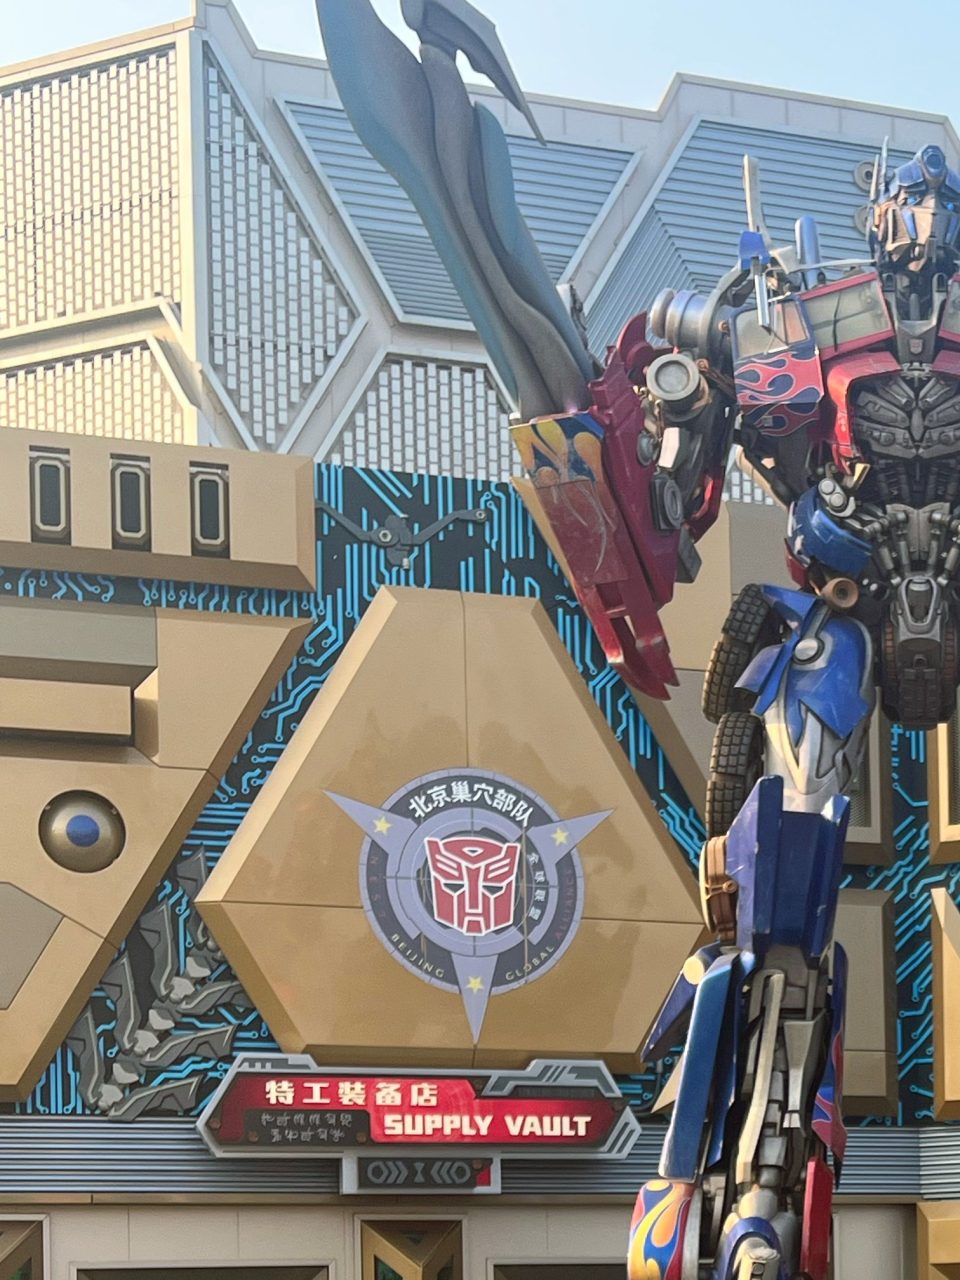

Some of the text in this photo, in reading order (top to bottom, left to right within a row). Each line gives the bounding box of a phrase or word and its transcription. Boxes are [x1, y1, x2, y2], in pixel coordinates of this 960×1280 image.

[408, 780, 534, 828] 北京巢穴部队
[391, 932, 446, 979] BEIJING
[505, 944, 555, 981] GLOBAL
[383, 1113, 592, 1137] SUPPLY VAULT
